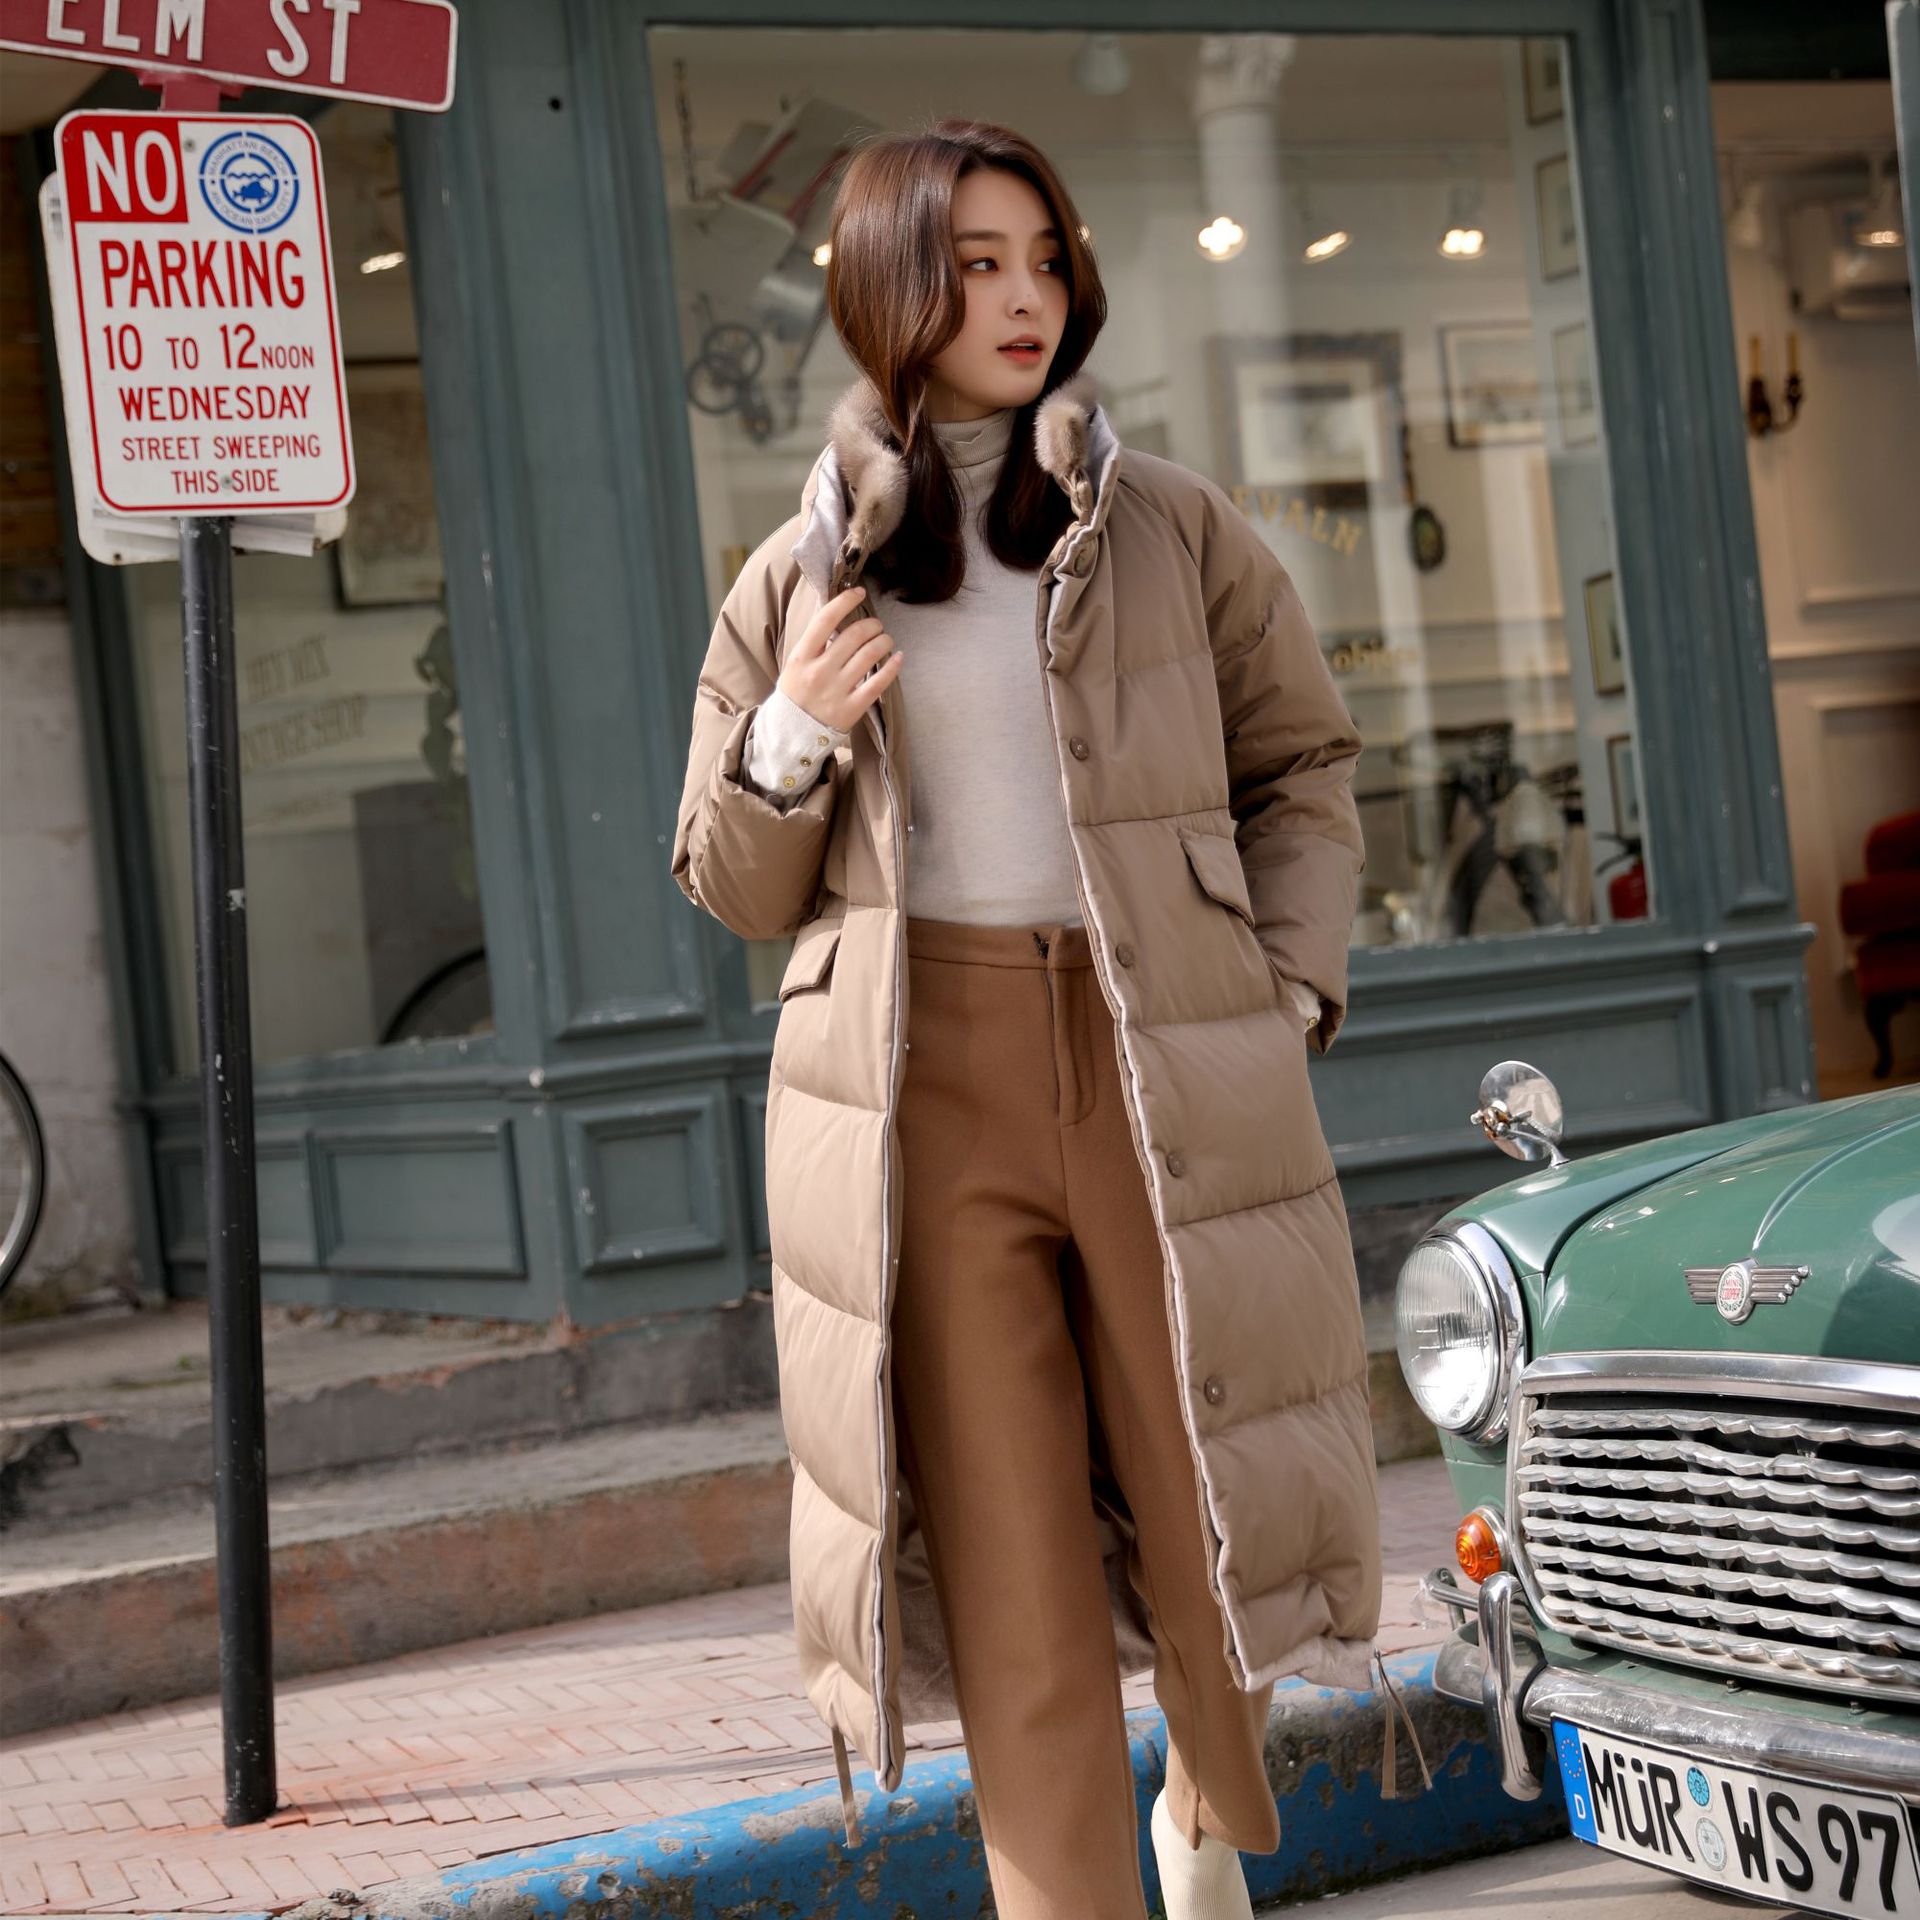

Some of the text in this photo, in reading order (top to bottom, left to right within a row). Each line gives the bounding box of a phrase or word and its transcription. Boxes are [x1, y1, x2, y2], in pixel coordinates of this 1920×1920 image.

[46, 0, 361, 84] ELM ST
[82, 130, 178, 216] NO
[100, 239, 304, 309] PARKING
[103, 323, 143, 371] 10
[166, 337, 199, 370] TO
[118, 385, 311, 422] WEDNESDAY
[122, 434, 321, 462] STREET SWEEPING
[171, 468, 280, 494] THIS SIDE
[1573, 1793, 1587, 1820] D
